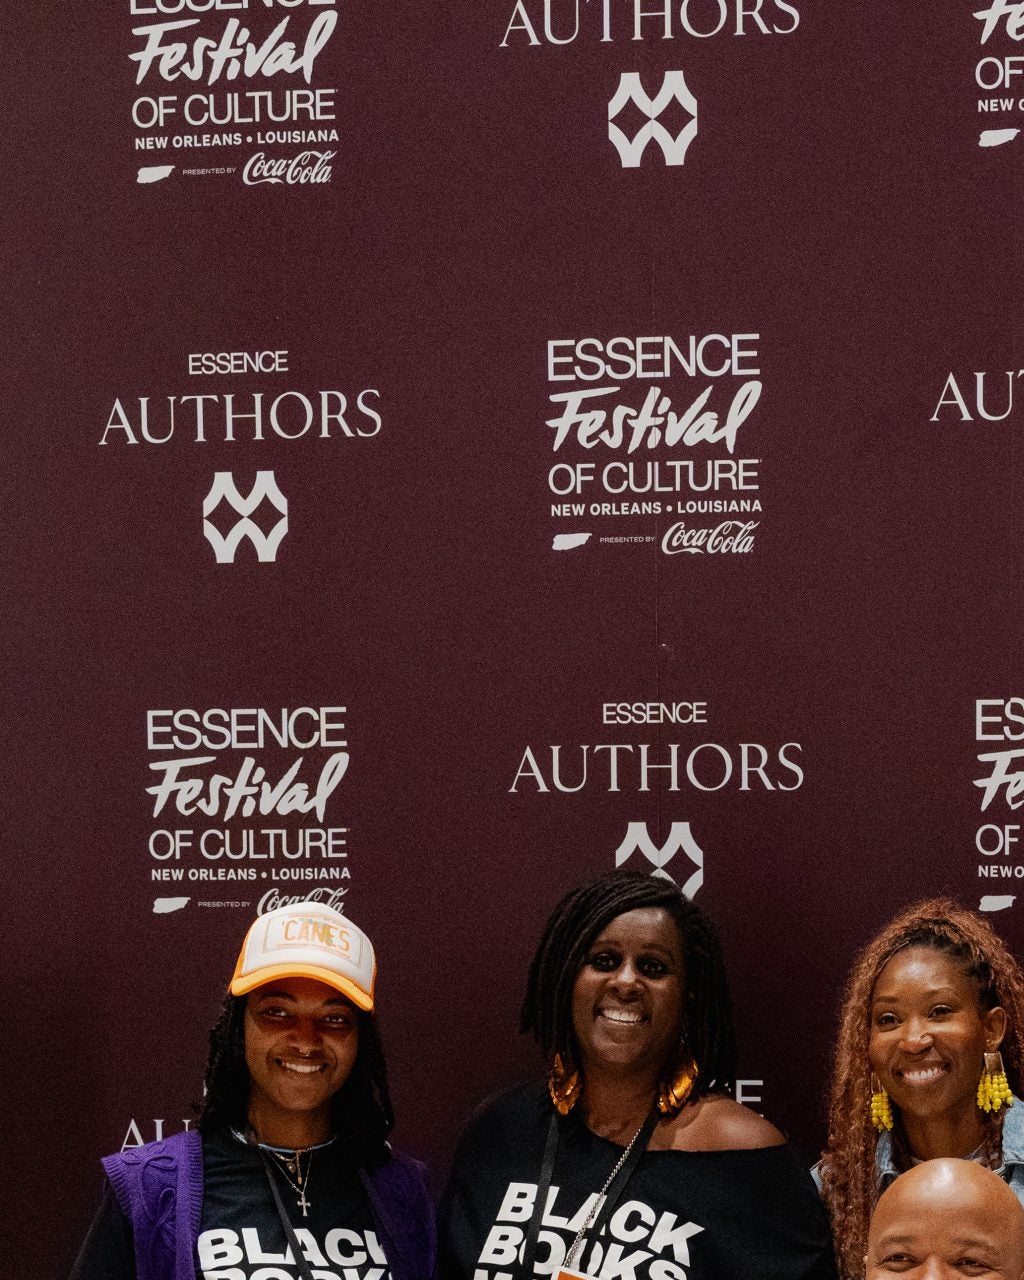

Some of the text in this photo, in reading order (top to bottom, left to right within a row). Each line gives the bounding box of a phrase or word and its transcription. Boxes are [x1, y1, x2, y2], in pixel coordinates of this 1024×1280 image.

[499, 0, 799, 46] AUTHORS
[128, 8, 338, 86] Festival
[975, 57, 1024, 89] OF
[132, 89, 335, 128] OF CULTURE
[978, 99, 1014, 112] NEW
[135, 130, 339, 149] NEW ORLEANS LOUISIANA
[182, 167, 225, 176] PRESENTED
[243, 151, 337, 185] Coca-Cola
[189, 351, 288, 374] ESSENCE
[548, 334, 761, 383] ESSENCE
[99, 390, 381, 445] AUTHORS
[545, 380, 762, 454] Festival
[549, 459, 759, 495] OF CULTURE
[552, 500, 762, 516] NEW ORLEANS LOUISIANA
[599, 536, 644, 544] PRESENTED
[662, 521, 759, 554] Coca-Cola
[147, 707, 347, 750] ESSENCE
[603, 702, 707, 724] ESSENCE
[508, 743, 803, 792] AUTHORS
[146, 752, 349, 823] Festival
[149, 828, 347, 860] OF CULTURE
[976, 824, 1020, 855] OF
[152, 867, 350, 880] NEW ORLEANS LOUISIANA
[496, 1182, 706, 1268] BLACK
